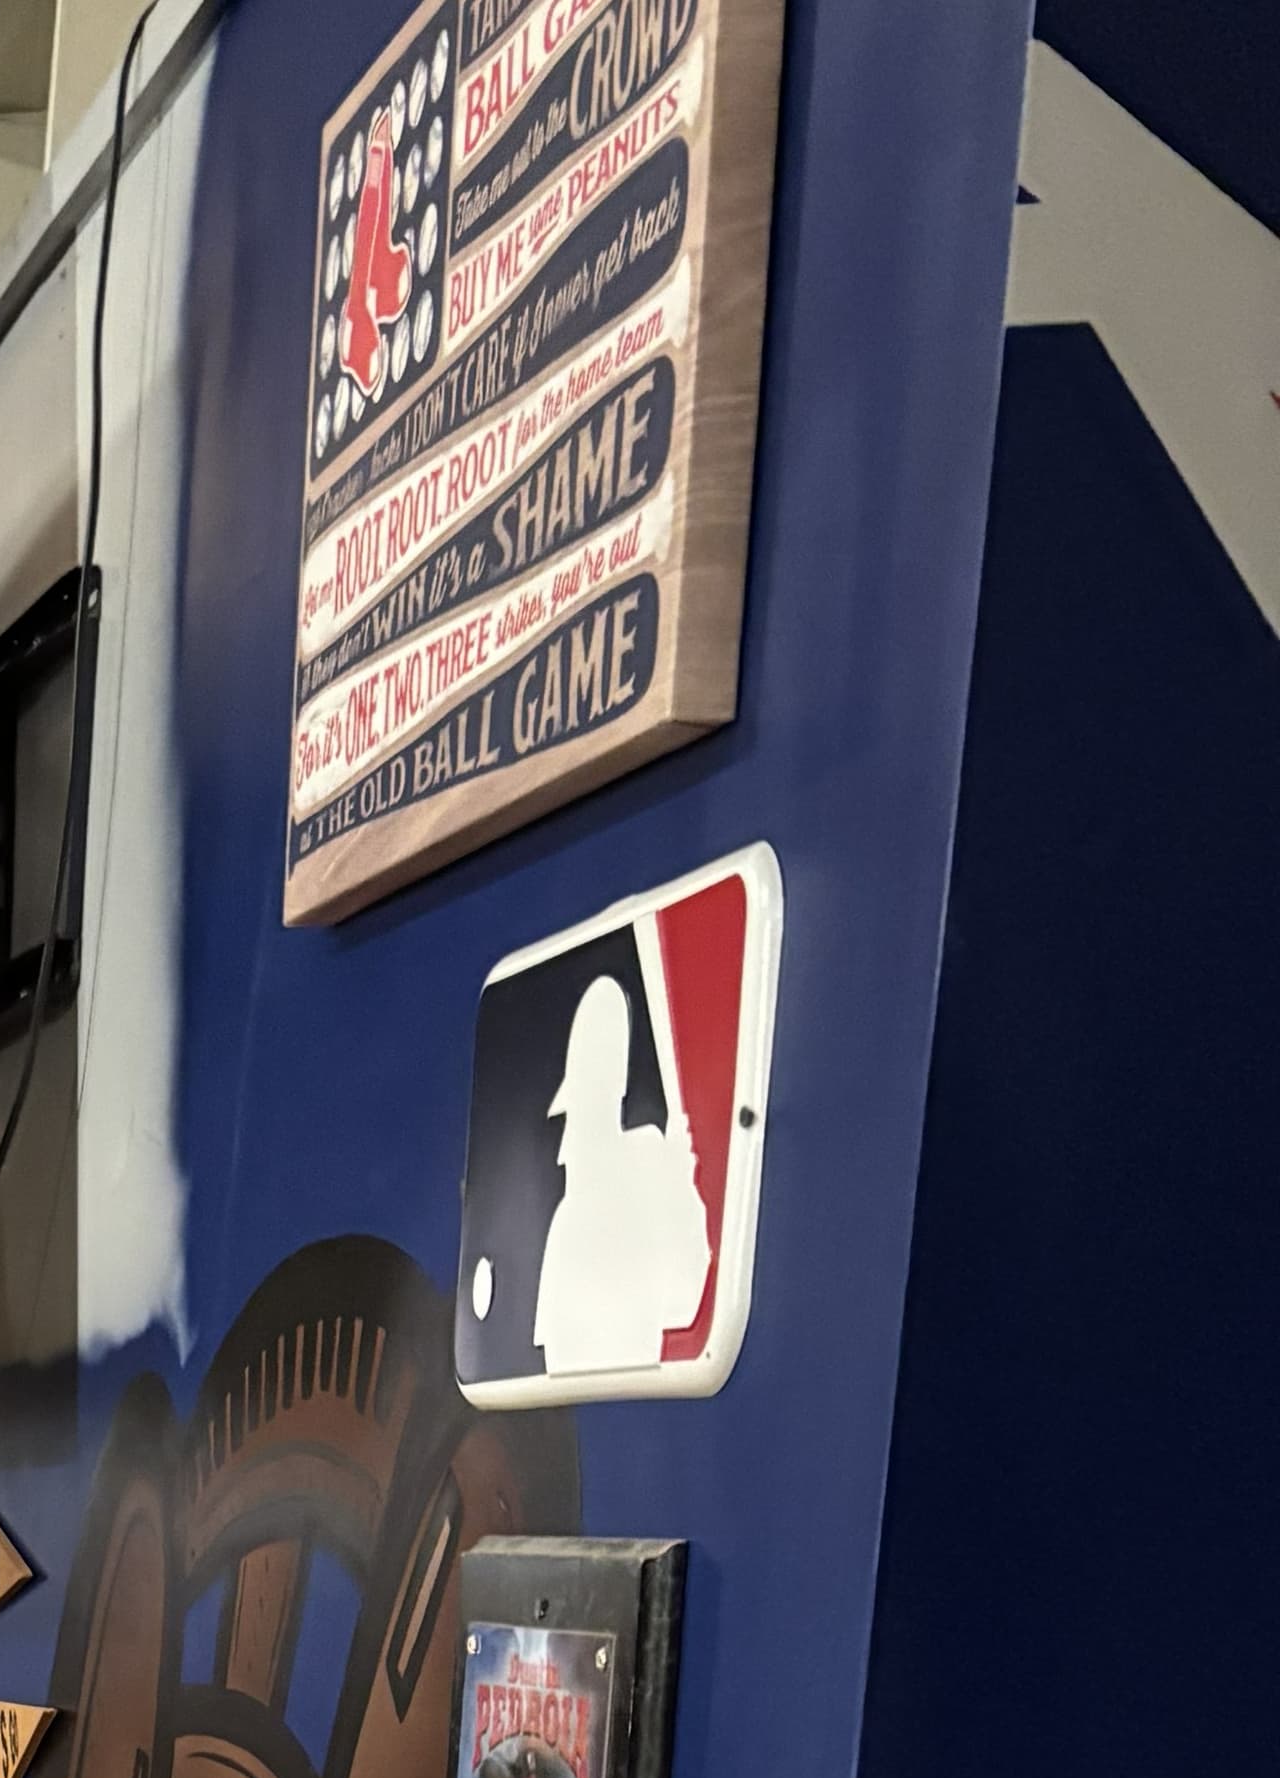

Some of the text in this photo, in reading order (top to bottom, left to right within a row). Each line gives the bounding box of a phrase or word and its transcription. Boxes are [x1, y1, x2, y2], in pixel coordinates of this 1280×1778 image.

[463, 24, 535, 160] BALL
[570, 0, 693, 139] CROWD
[448, 79, 681, 340] BUY ME some PEANUTS
[462, 313, 512, 417] CARE
[593, 217, 629, 313] get
[629, 176, 681, 264] back
[371, 564, 429, 648] WIN
[493, 366, 656, 571] SHAME
[445, 417, 512, 519] ROOT
[540, 386, 563, 431] the
[564, 345, 614, 406] home
[614, 306, 664, 369] team
[315, 785, 357, 841] THE
[360, 756, 406, 819] OLD
[413, 690, 501, 797] BALL
[513, 590, 641, 755] GAME
[426, 610, 493, 702] THREE
[550, 545, 607, 620] you're
[608, 511, 643, 574] out
